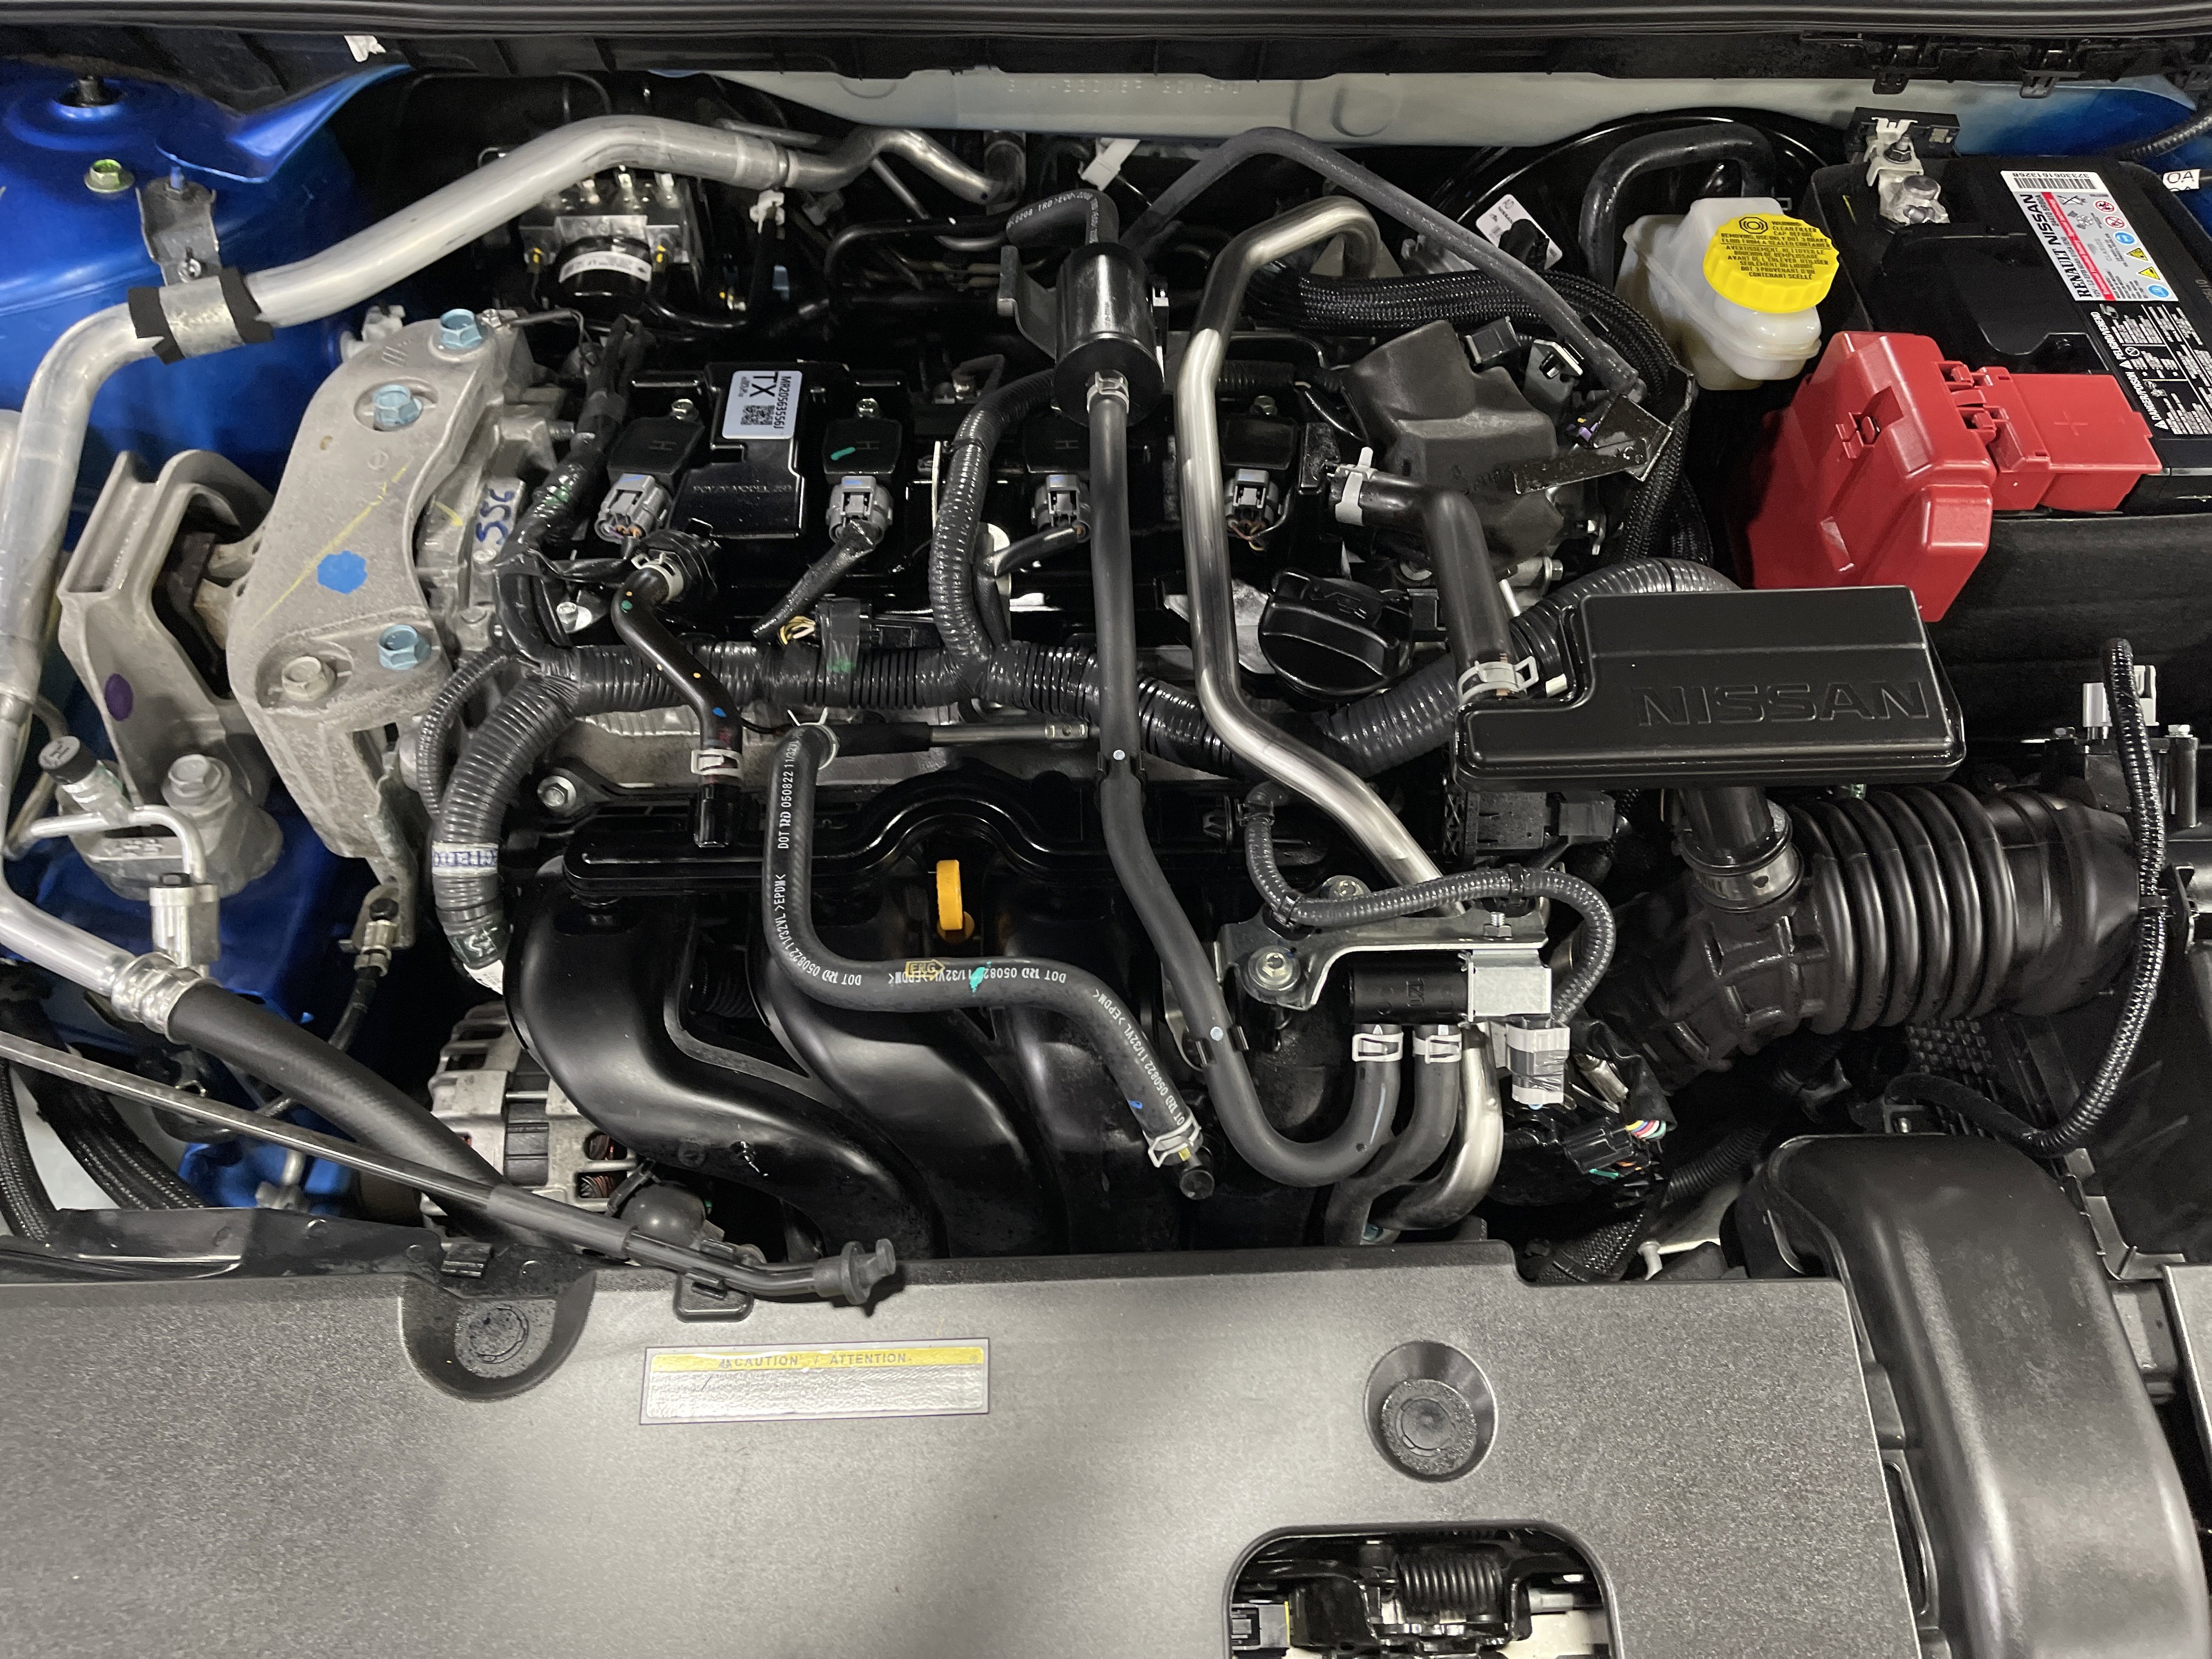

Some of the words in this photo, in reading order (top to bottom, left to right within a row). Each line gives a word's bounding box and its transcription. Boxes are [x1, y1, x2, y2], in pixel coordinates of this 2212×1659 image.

[2019, 194, 2061, 244] NISSAN
[2051, 249, 2092, 297] RENAULT
[2090, 312, 2126, 360] PELIGRO/VENENO
[749, 371, 778, 397] TX
[2125, 372, 2162, 420] DANGER/POISON
[774, 376, 792, 429] MR20563556J
[1631, 681, 1929, 727] NISSAN
[781, 771, 794, 808] 050822
[777, 831, 790, 849] DOT
[789, 947, 821, 977] 050822
[979, 967, 1017, 979] 05082
[1045, 970, 1066, 984] DOT
[841, 973, 862, 986] DOT
[1144, 1060, 1169, 1096] 050822
[1173, 1111, 1186, 1126] OT
[734, 1356, 798, 1367] CAUTION
[830, 1353, 906, 1365] ATTENTION
